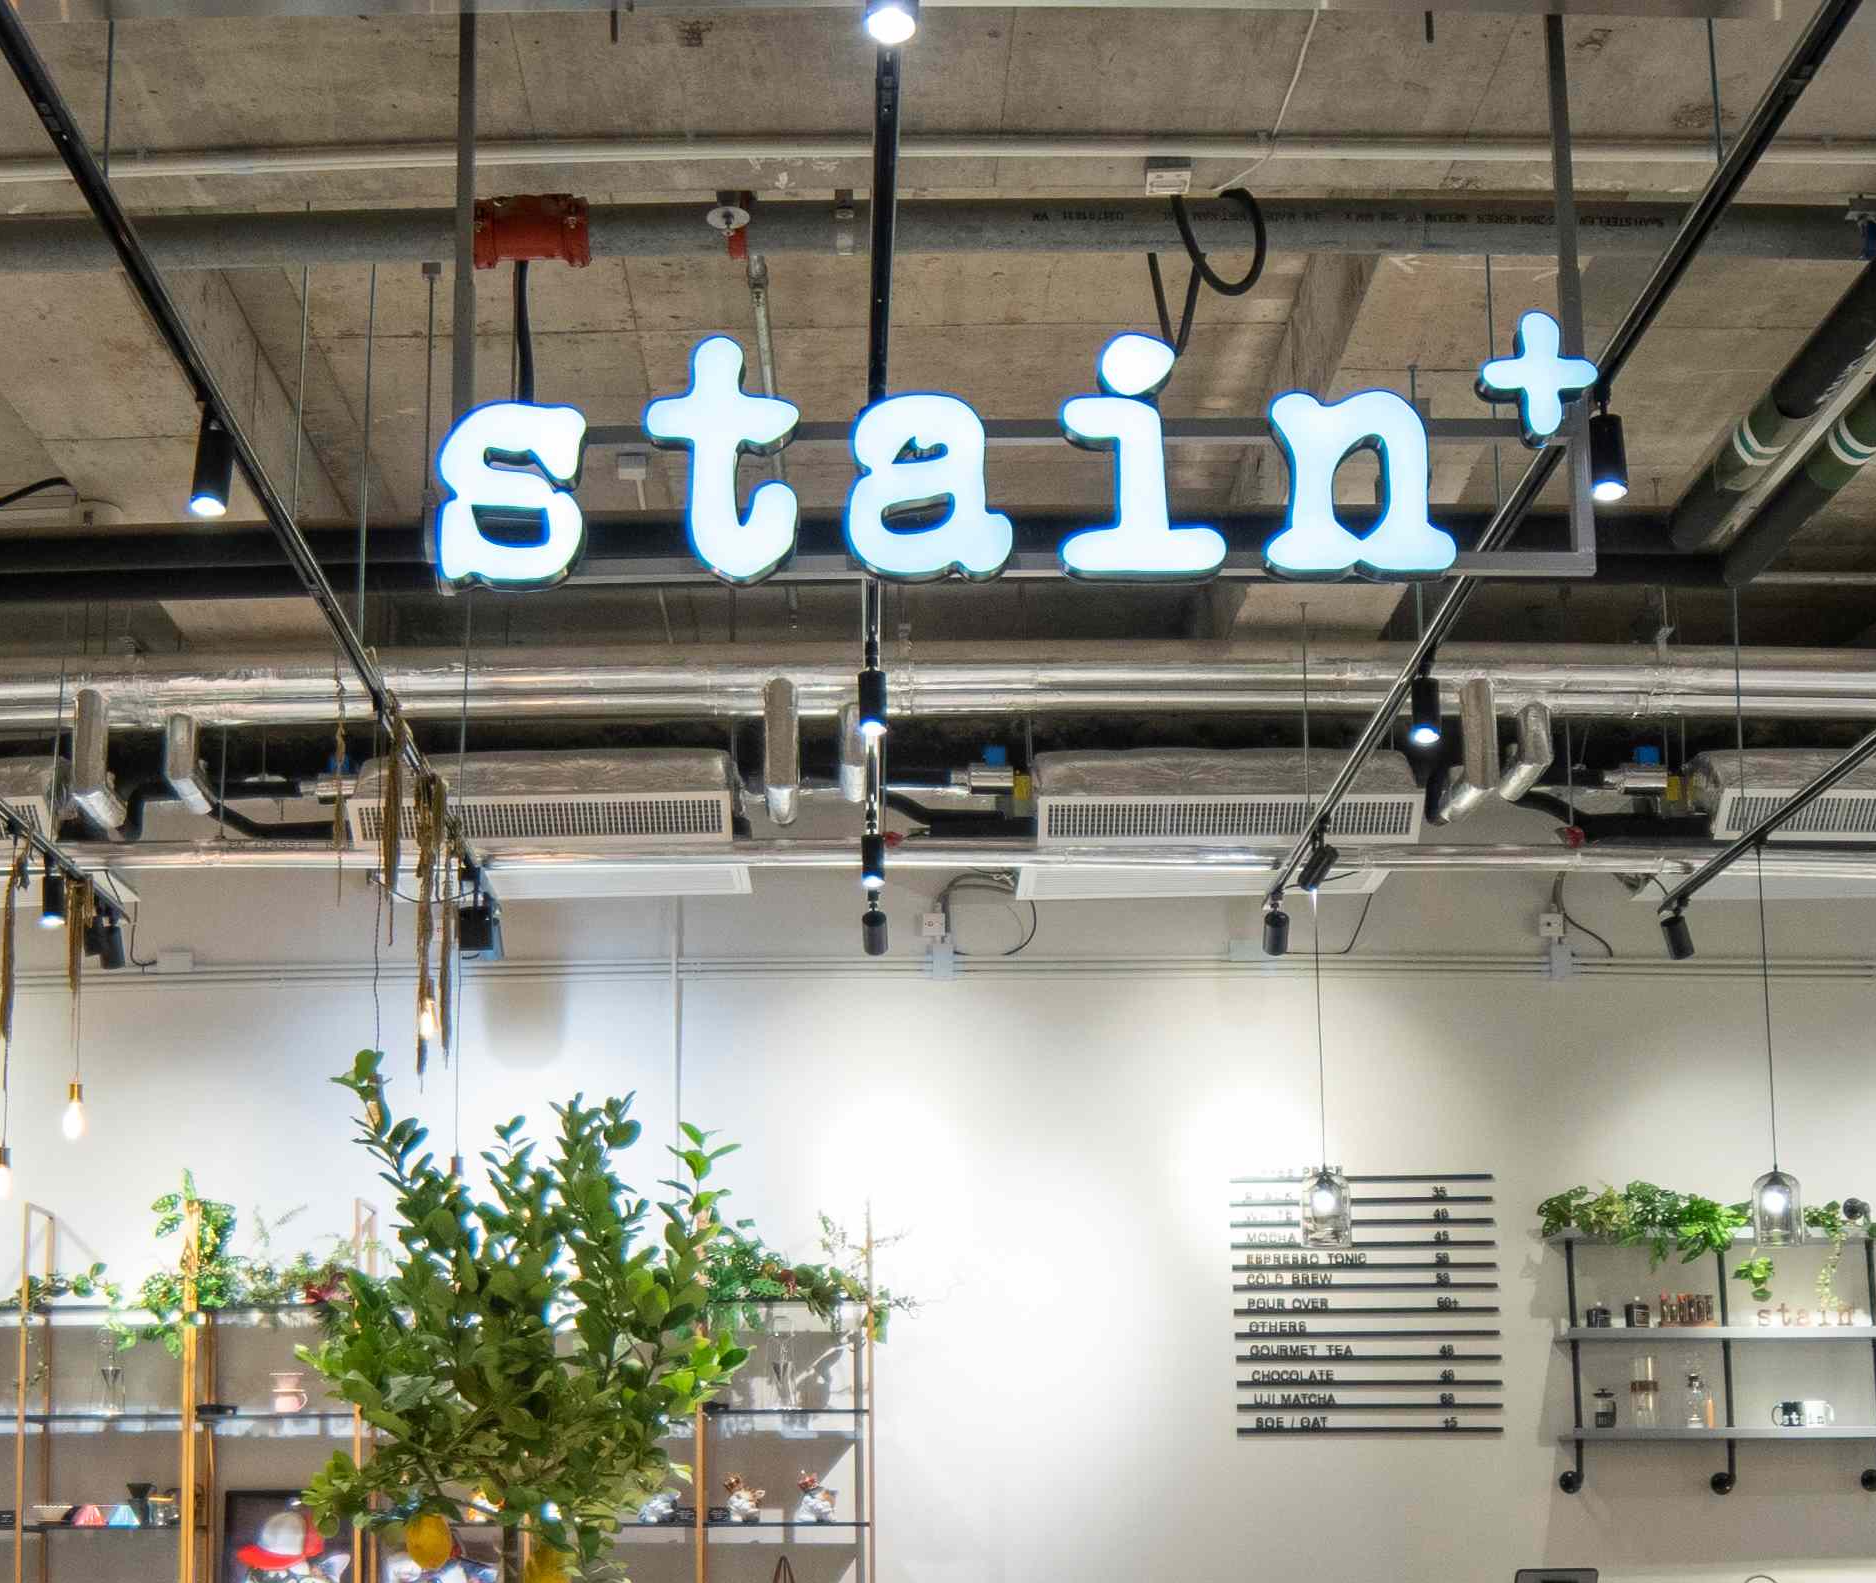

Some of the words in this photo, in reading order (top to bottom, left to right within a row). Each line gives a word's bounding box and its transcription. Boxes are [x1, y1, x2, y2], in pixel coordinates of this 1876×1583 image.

[1246, 1231, 1297, 1243] MOCHA
[1246, 1253, 1320, 1265] ESPRESSO
[1327, 1252, 1367, 1265] TONIC
[1246, 1272, 1284, 1285] COLD
[1292, 1272, 1333, 1285] BREW
[1247, 1297, 1286, 1309] POUR
[1292, 1297, 1329, 1309] OVER
[1248, 1320, 1307, 1333] OTHERS
[1249, 1344, 1317, 1356] GOURMET
[1326, 1344, 1354, 1356] TEA
[1251, 1369, 1335, 1381] CHOCOLATE
[1253, 1393, 1276, 1405] UJI
[1280, 1393, 1336, 1405] MATCHA
[1300, 1416, 1328, 1429] OAT
